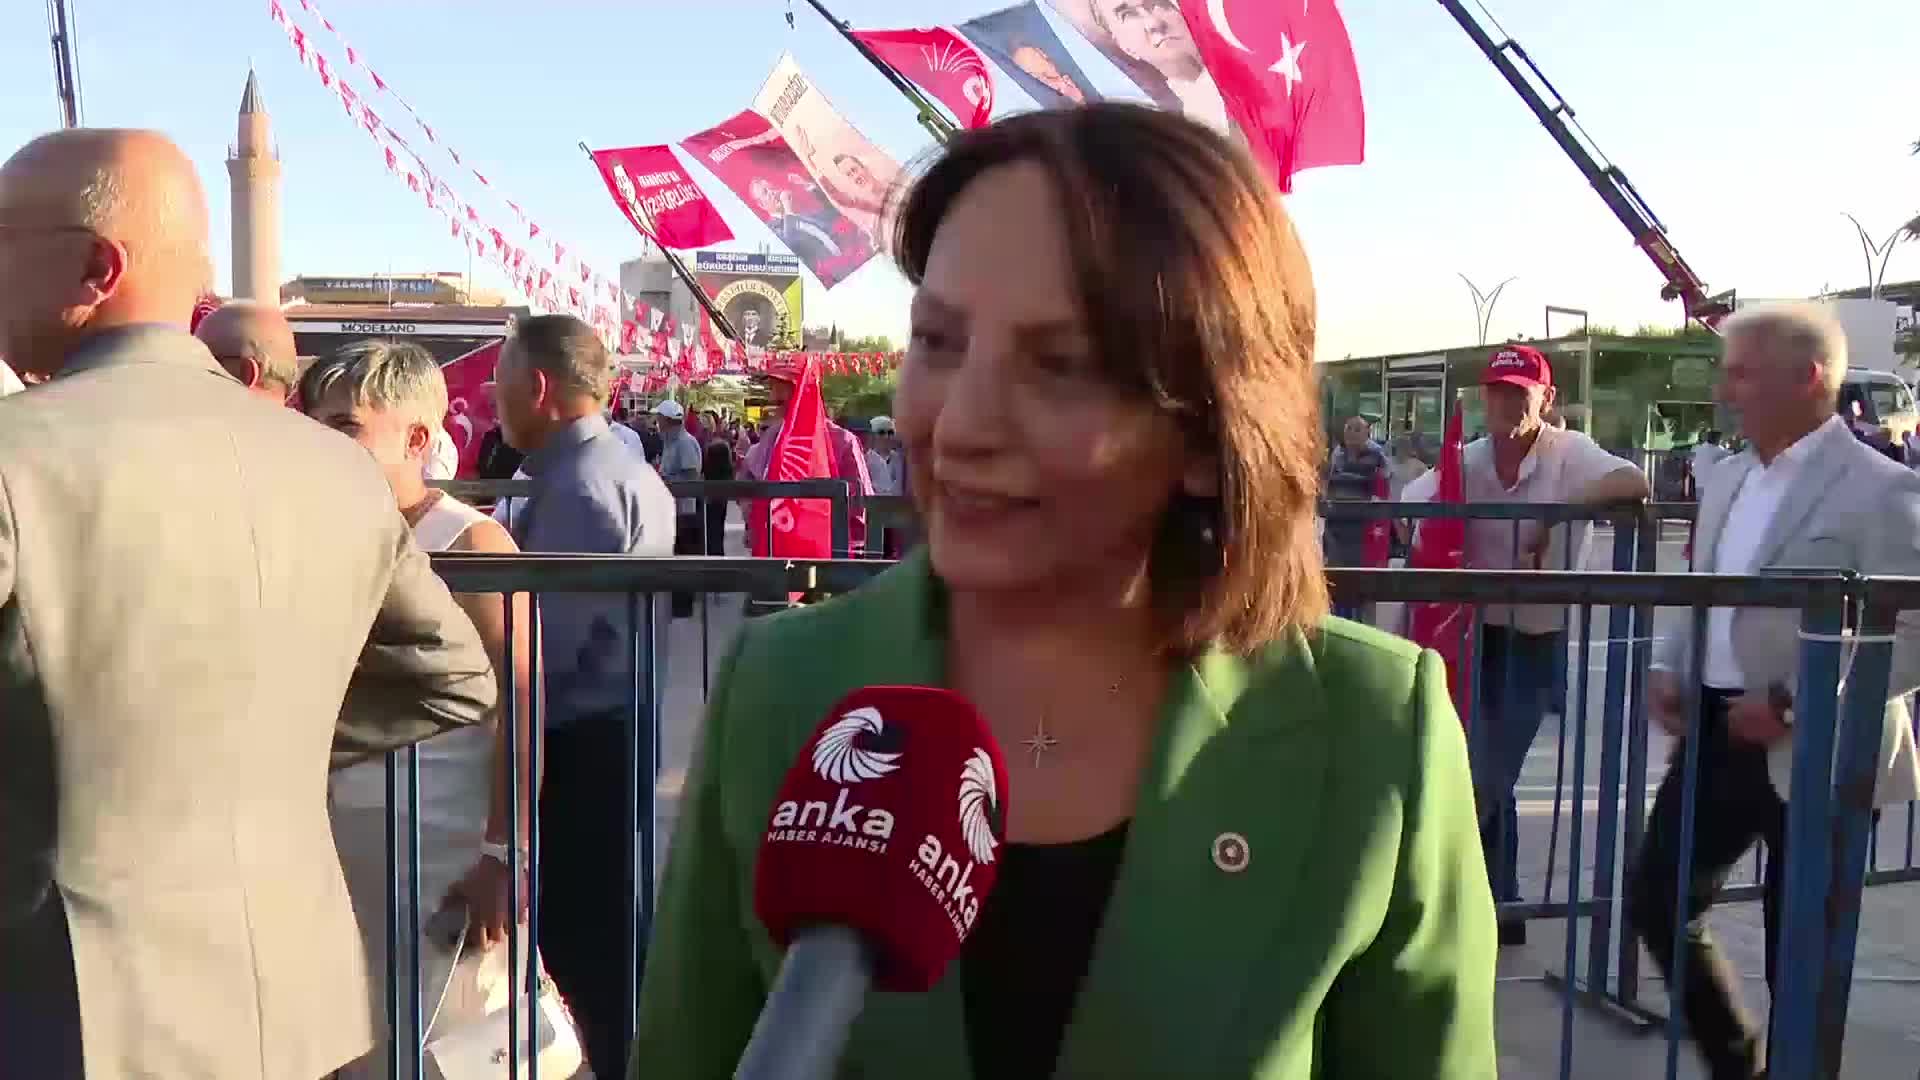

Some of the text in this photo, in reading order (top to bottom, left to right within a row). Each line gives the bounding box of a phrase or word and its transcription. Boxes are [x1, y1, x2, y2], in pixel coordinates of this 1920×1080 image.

[341, 323, 416, 333] MODELAND
[772, 788, 895, 840] anka
[767, 830, 889, 854] HABER AJANSI
[909, 859, 946, 905] HABER
[918, 834, 979, 929] anka
